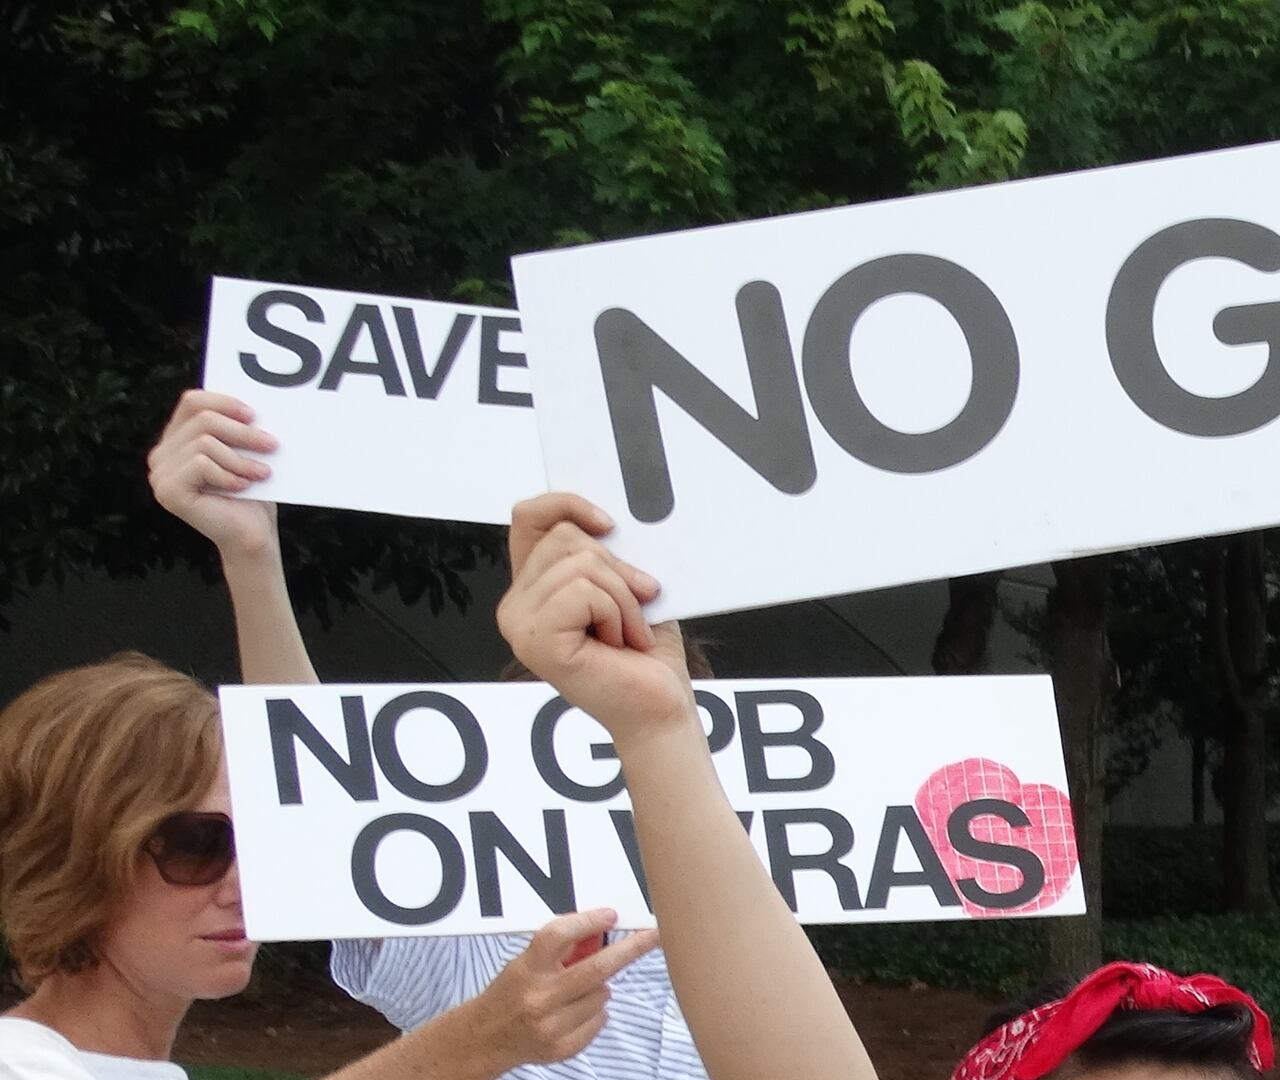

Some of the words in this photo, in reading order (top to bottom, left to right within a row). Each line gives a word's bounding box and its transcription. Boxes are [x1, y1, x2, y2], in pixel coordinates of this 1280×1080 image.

[239, 289, 535, 409] SAVE
[593, 252, 1021, 525] NO
[265, 689, 489, 806] NO
[350, 808, 578, 926] ON
